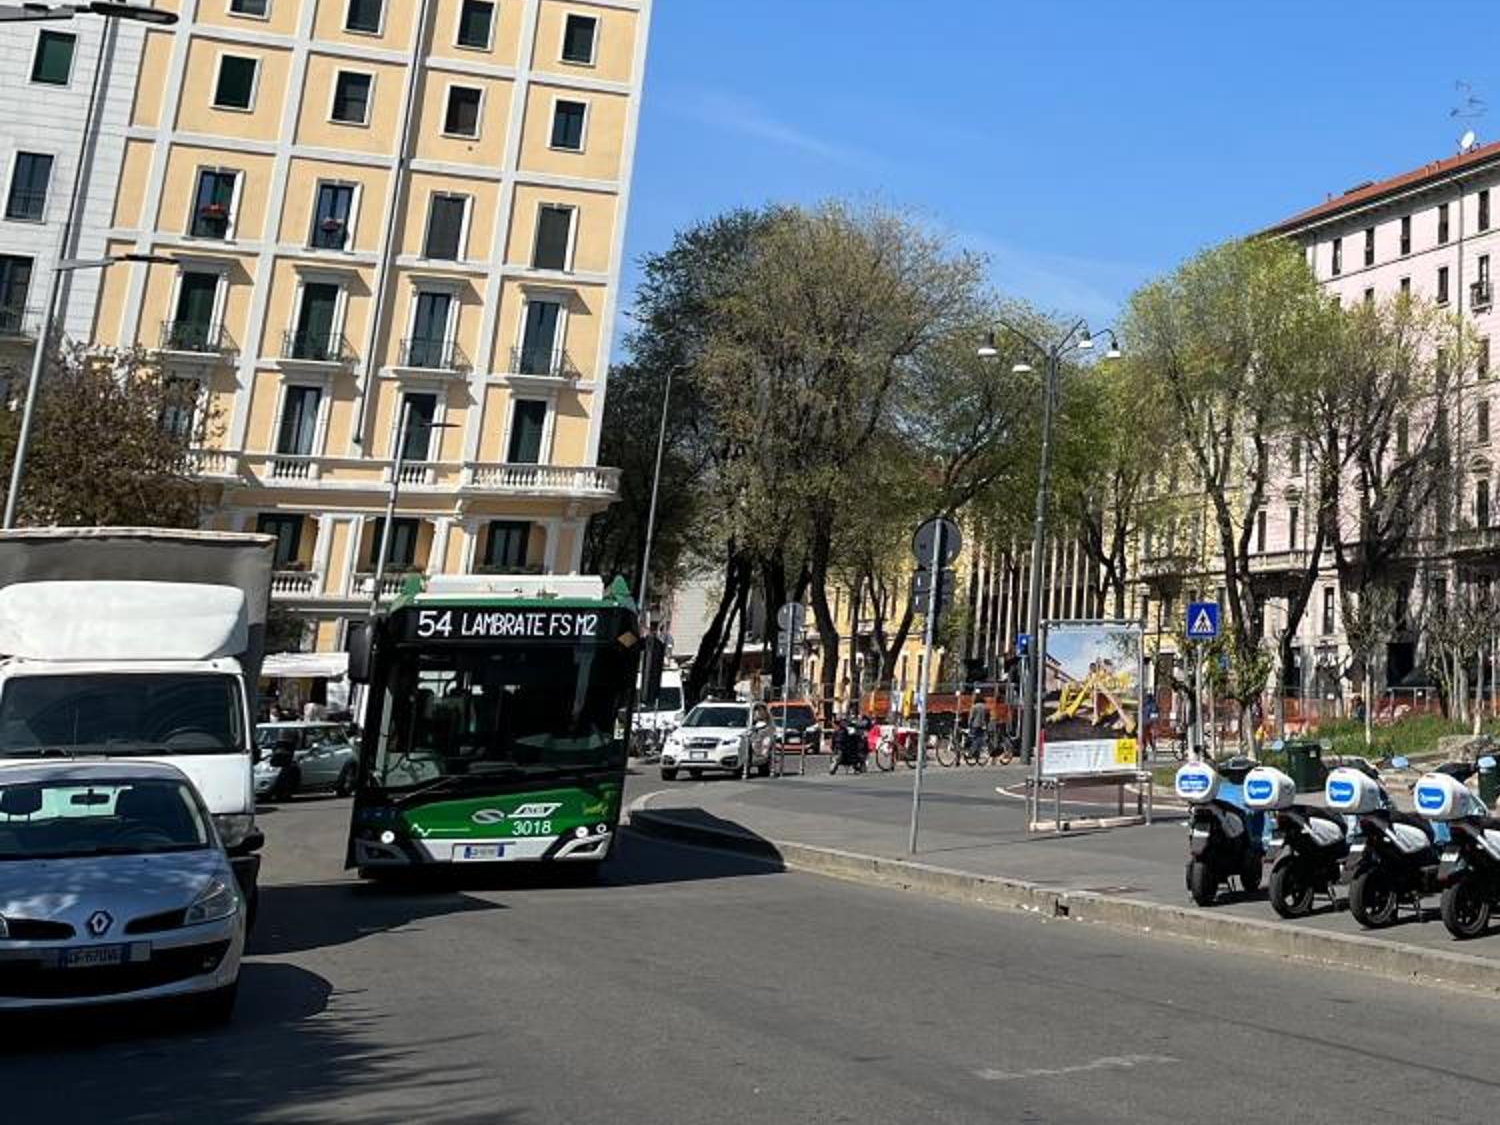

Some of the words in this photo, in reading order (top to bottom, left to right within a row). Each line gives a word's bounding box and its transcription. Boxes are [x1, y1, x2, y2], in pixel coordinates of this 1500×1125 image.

[417, 610, 453, 637] 54
[461, 612, 547, 636] LAMBRATE
[549, 613, 573, 636] FS
[574, 614, 598, 636] M2
[512, 820, 552, 836] 3018
